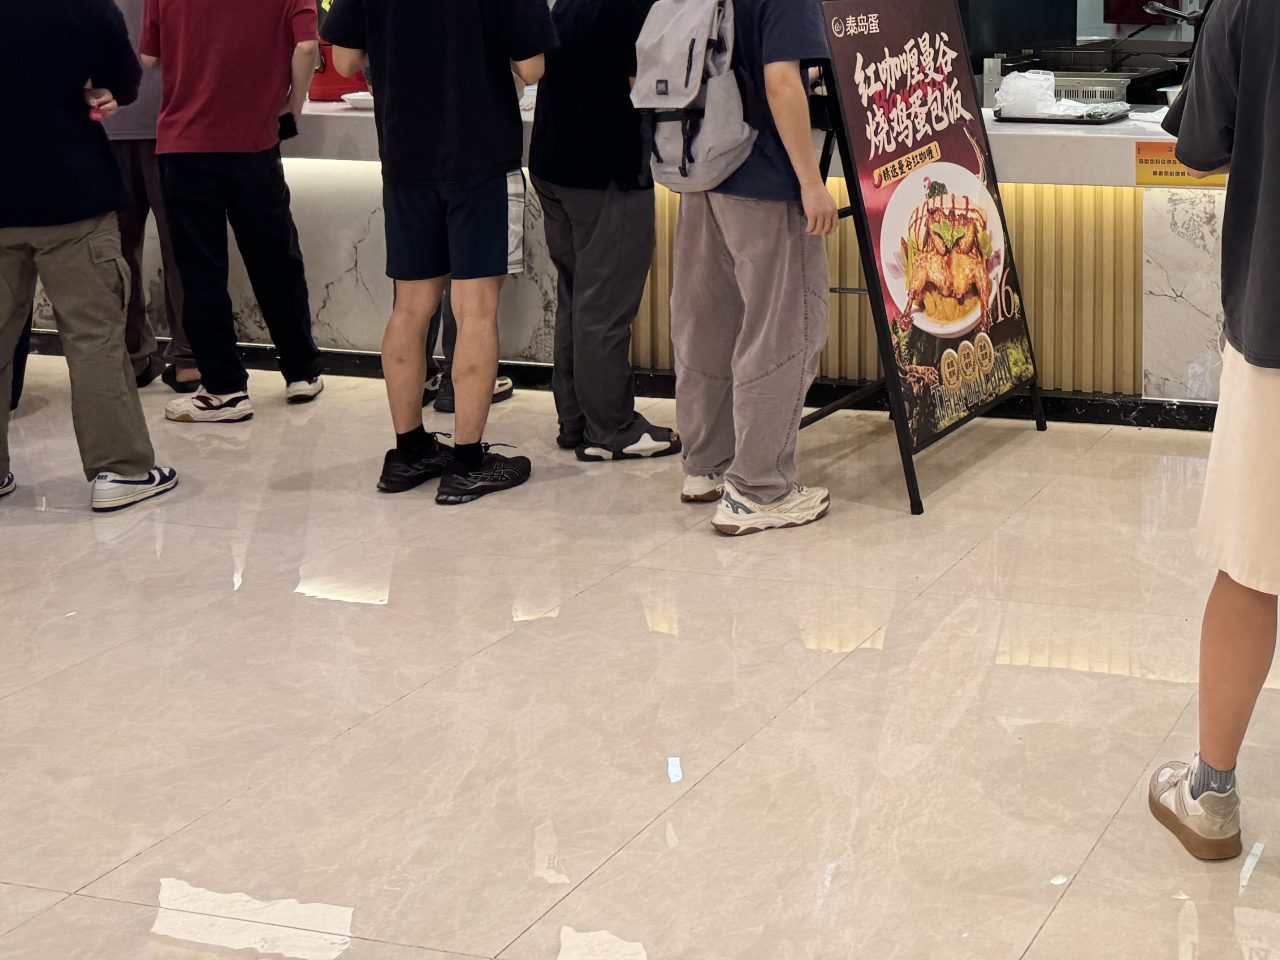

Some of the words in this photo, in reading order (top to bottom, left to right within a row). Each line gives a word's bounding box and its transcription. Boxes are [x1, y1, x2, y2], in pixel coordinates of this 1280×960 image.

[845, 13, 880, 37] 泰岛蛋
[854, 31, 958, 108] 红咖喱曼谷
[866, 77, 974, 161] 烧鸡蛋包饭
[883, 145, 934, 182] 精选曼谷红咖喱
